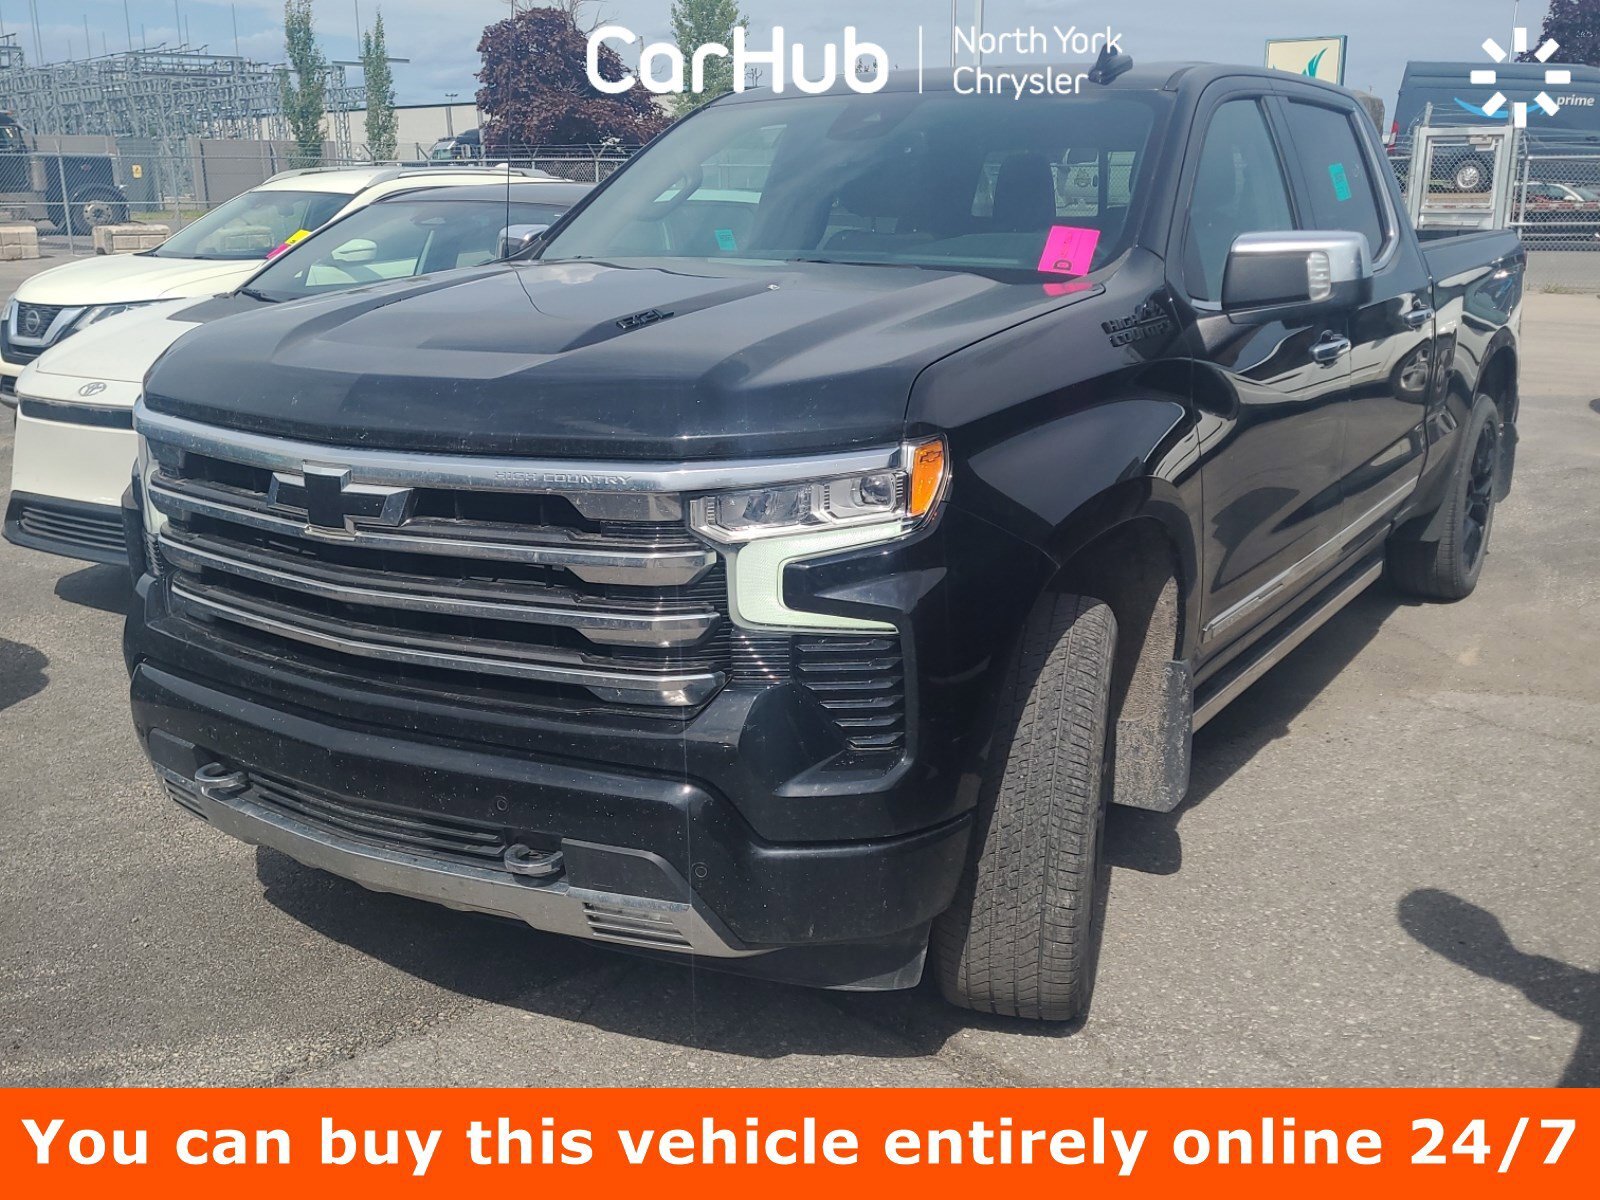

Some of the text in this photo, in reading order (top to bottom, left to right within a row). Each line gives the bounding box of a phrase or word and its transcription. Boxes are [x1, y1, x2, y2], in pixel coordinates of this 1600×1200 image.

[1556, 94, 1595, 107] prime
[494, 471, 632, 485] HIGH COUNTRY
